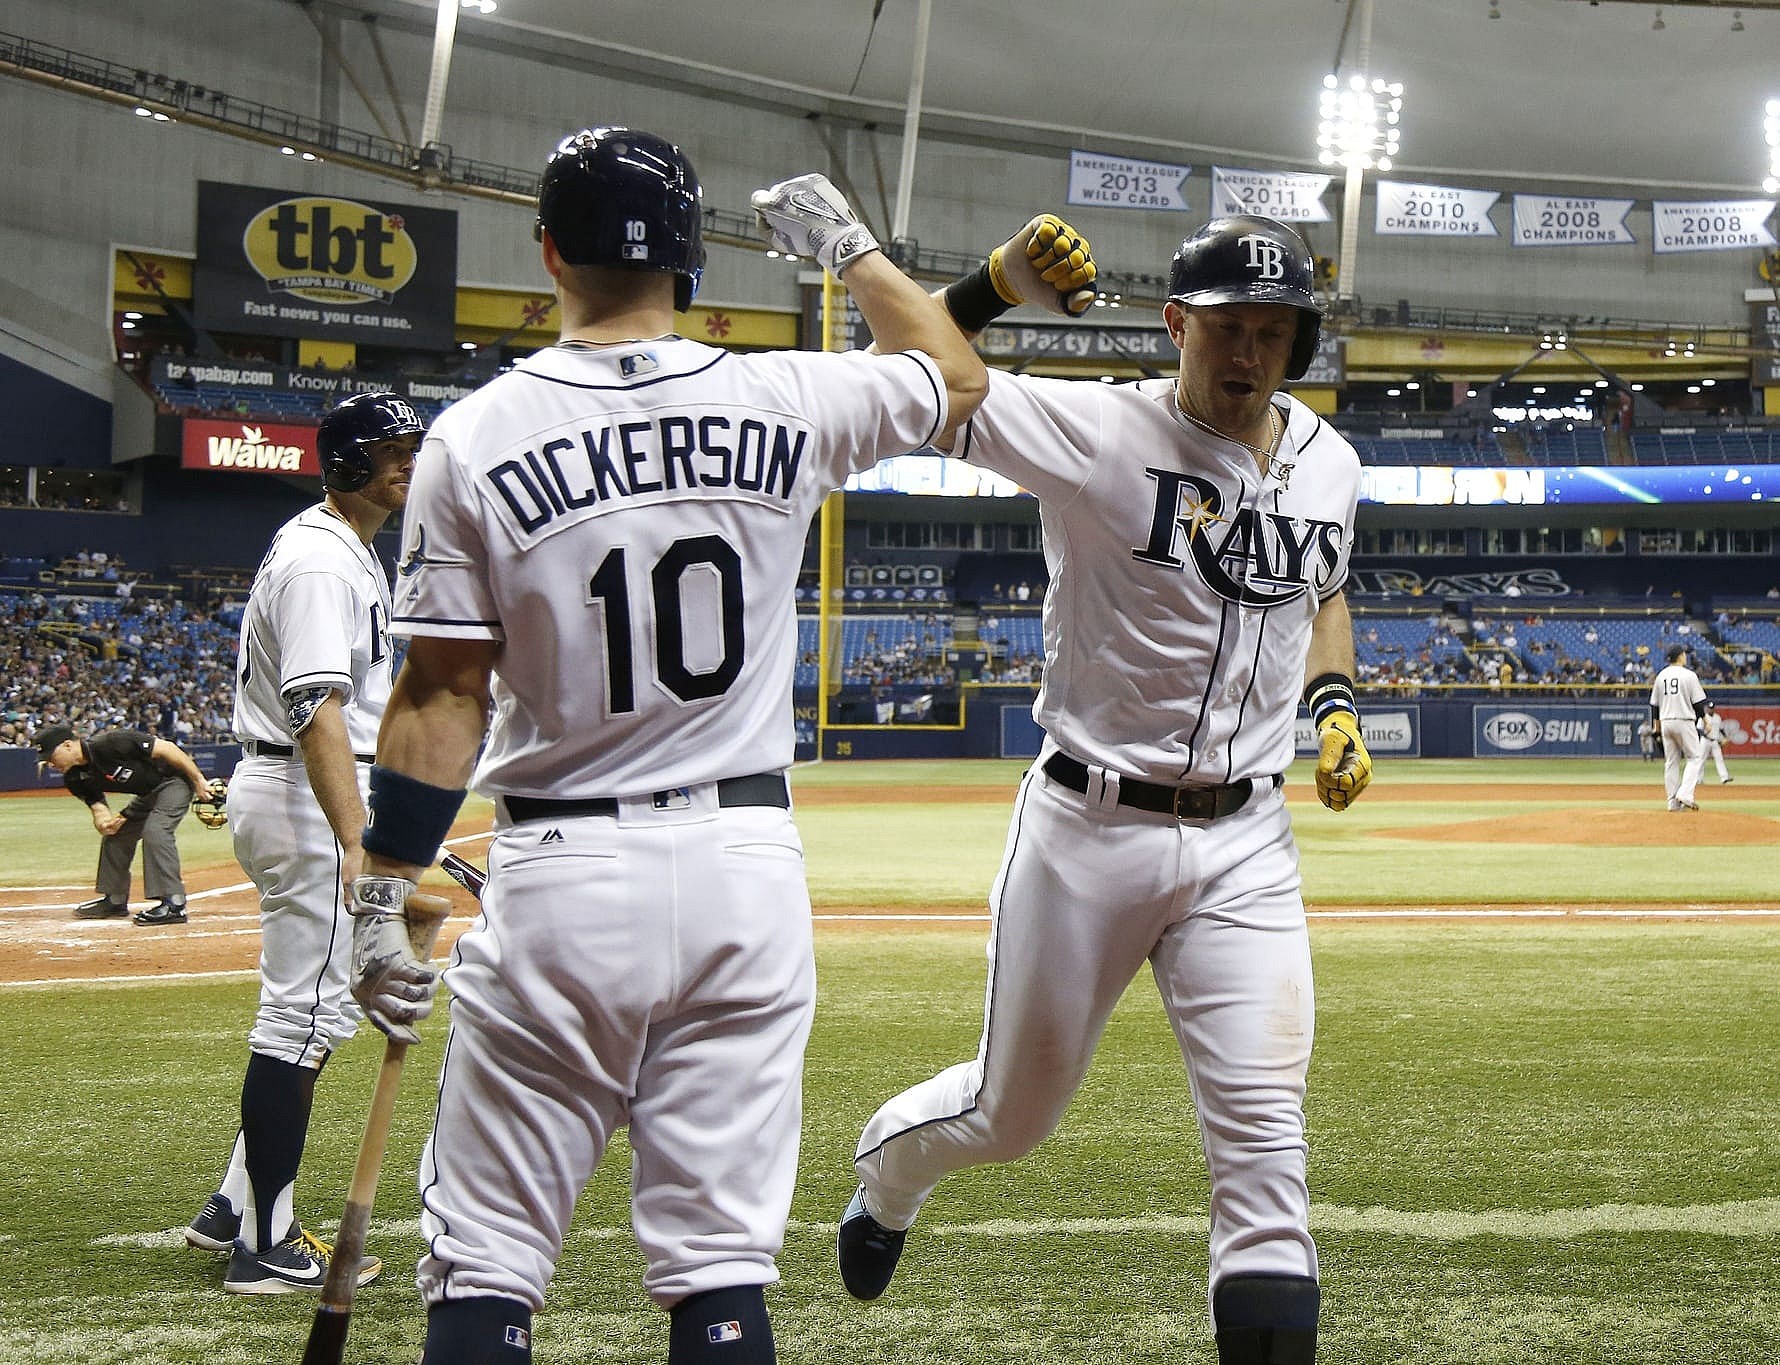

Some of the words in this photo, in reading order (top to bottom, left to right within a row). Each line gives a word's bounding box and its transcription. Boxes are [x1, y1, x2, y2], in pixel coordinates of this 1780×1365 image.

[1075, 158, 1133, 172] AMERICAN
[1138, 166, 1181, 178] LEAGUE
[1100, 172, 1157, 193] 2013
[1082, 188, 1120, 201] WILD
[1128, 193, 1170, 206] CARD
[1241, 187, 1296, 205] 2011
[1430, 191, 1462, 200] EAST
[1545, 200, 1561, 209] AL
[1566, 200, 1597, 210] EAST
[1270, 206, 1310, 217] CARD
[1404, 200, 1464, 218] 2010
[1385, 217, 1480, 233] CHAMPIONS
[1541, 211, 1601, 228] 2008
[1682, 216, 1742, 234] 2008
[626, 220, 646, 242] 10
[1522, 228, 1617, 241] CHAMPIONS
[1663, 234, 1760, 247] CHAMPIONS
[269, 204, 395, 280] tbt
[1238, 233, 1285, 280] TB
[283, 277, 322, 288] TAMPA
[325, 278, 346, 290] BAY
[349, 281, 385, 299] TIMES
[243, 300, 277, 317] Fast
[279, 305, 320, 321] news
[323, 310, 350, 325] you
[353, 312, 380, 327] can
[382, 315, 412, 330] use.
[288, 371, 339, 392] Know
[341, 375, 353, 393] it
[207, 435, 303, 471] Wawa
[486, 415, 808, 535] DICKERSON
[1131, 466, 1346, 607] RAYS
[586, 533, 746, 719] 10
[1663, 678, 1679, 696] 19
[1497, 720, 1529, 735] FOX
[1543, 719, 1590, 742] SUN
